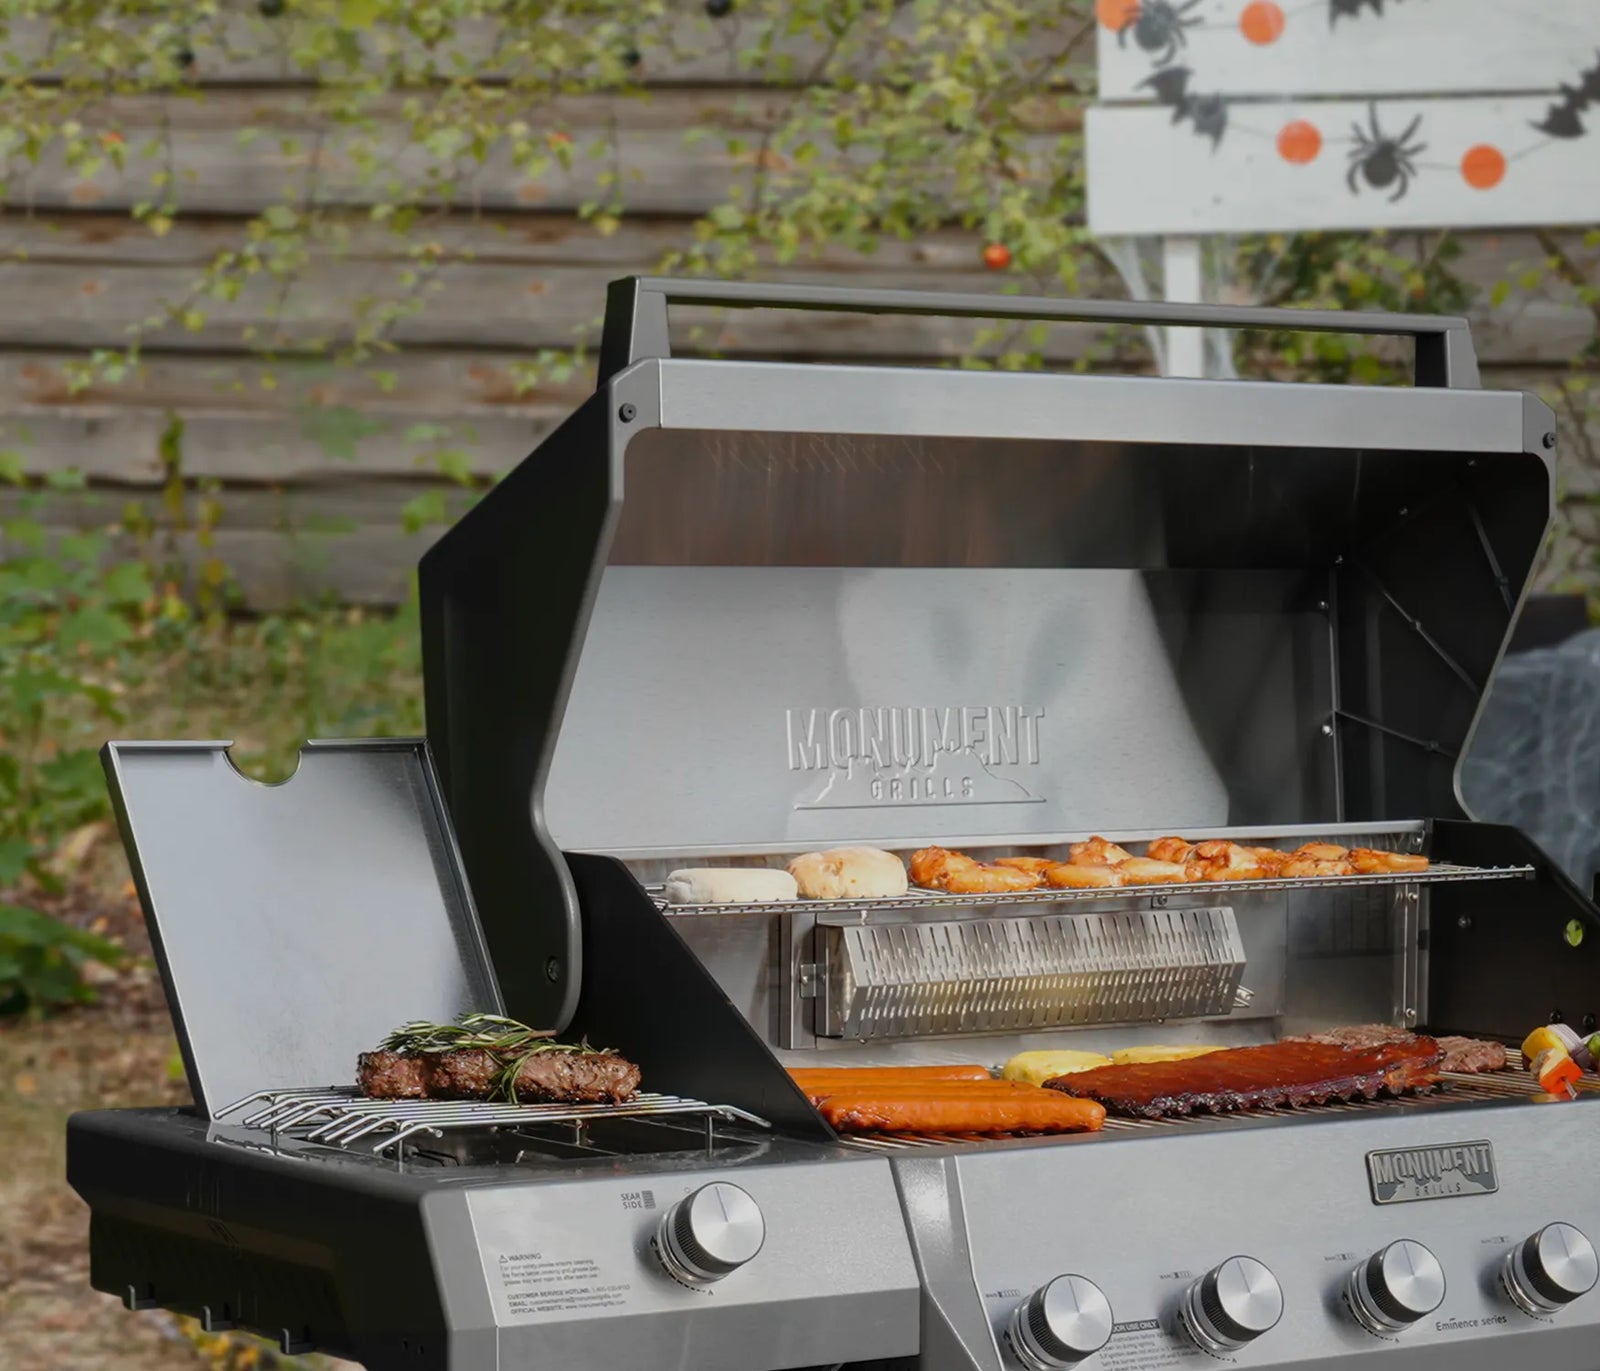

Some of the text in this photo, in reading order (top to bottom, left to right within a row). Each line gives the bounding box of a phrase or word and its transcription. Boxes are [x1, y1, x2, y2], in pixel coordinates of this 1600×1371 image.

[786, 706, 1045, 770] MONUMENT
[871, 776, 974, 800] GRILLS
[1373, 1146, 1489, 1184] MONUMENT
[1415, 1182, 1461, 1196] GRILLS
[621, 1193, 641, 1201] SEAR
[622, 1200, 642, 1209] SIDE
[508, 1252, 542, 1261] WARNING
[1140, 1320, 1157, 1330] ONLY
[1435, 1314, 1508, 1332] Eminence series
